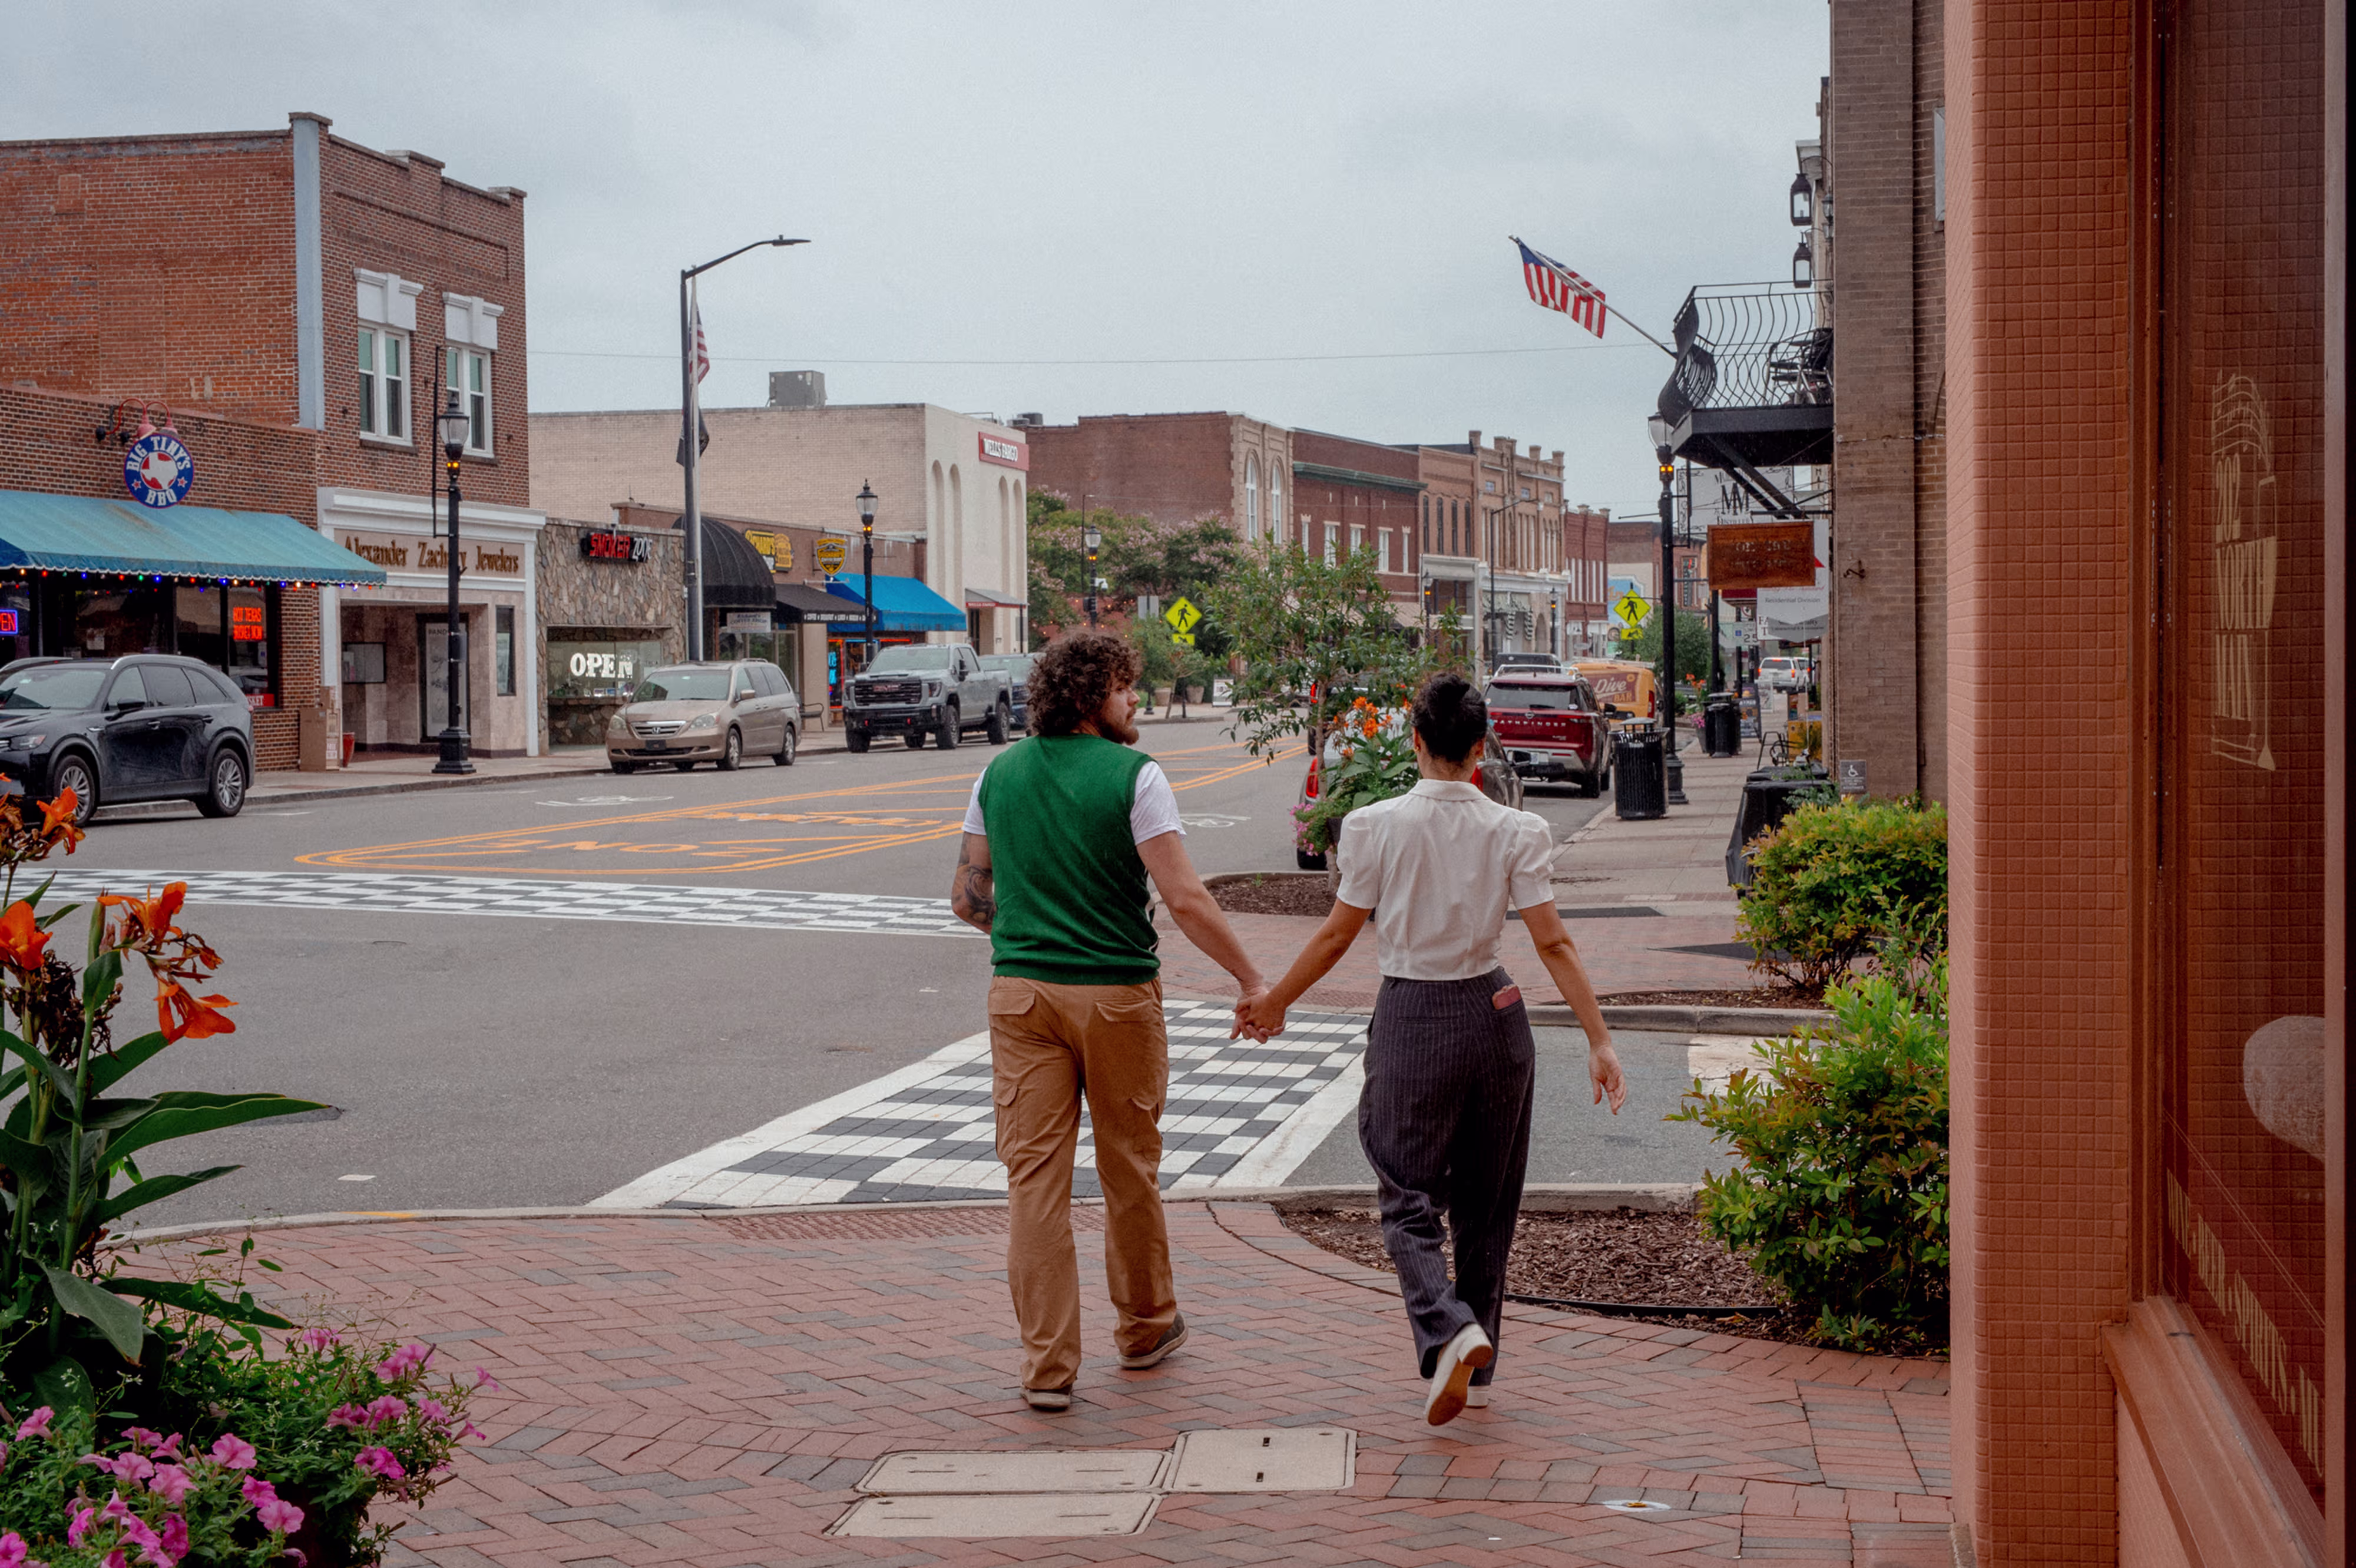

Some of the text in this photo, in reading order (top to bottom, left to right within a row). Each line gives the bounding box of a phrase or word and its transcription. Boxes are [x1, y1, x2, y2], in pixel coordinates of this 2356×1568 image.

[126, 436, 190, 472] BIG TINY'S
[984, 438, 1018, 462] WELLS FARGO
[145, 488, 177, 506] BBQ
[2215, 452, 2241, 543] 202
[417, 541, 466, 568] Zachy
[475, 545, 519, 573] Jewelers
[590, 532, 653, 563] SMOKER ZONE
[2215, 536, 2267, 630] NORTH
[0, 613, 16, 631] EN
[1743, 634, 1758, 643] 25
[570, 653, 633, 679] OPEN
[2215, 634, 2253, 722] MAIN
[1593, 677, 1627, 693] Dive
[1614, 693, 1632, 702] BAR
[2198, 1212, 2226, 1316] BEER
[2234, 1269, 2287, 1416] SPIRITS
